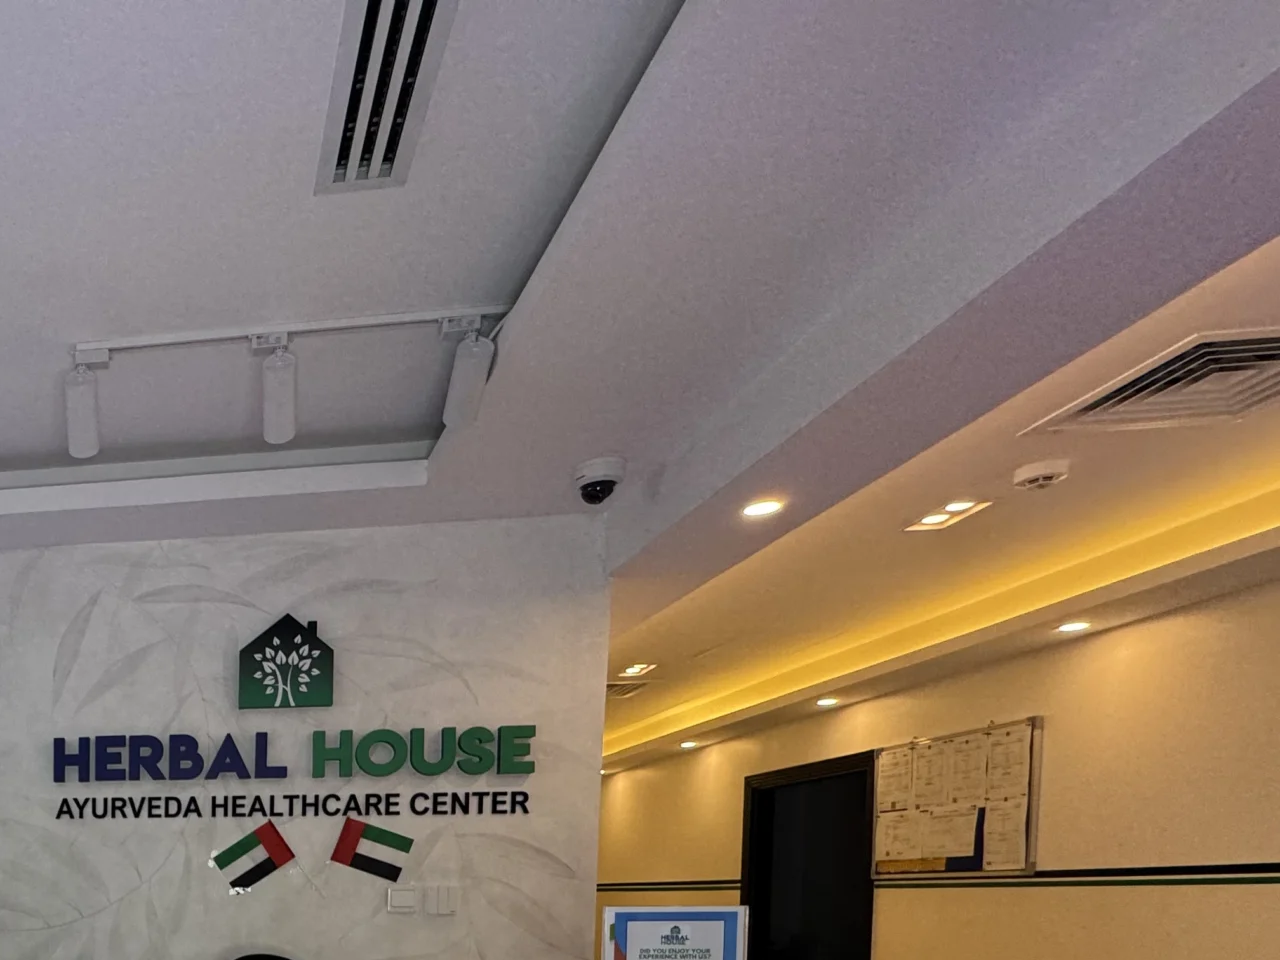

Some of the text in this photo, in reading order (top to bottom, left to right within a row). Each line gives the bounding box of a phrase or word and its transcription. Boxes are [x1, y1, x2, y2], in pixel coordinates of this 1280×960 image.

[53, 725, 536, 782] HERBAL HOUSE
[55, 791, 529, 820] AYURVEDA HEALTHCARE CENTER
